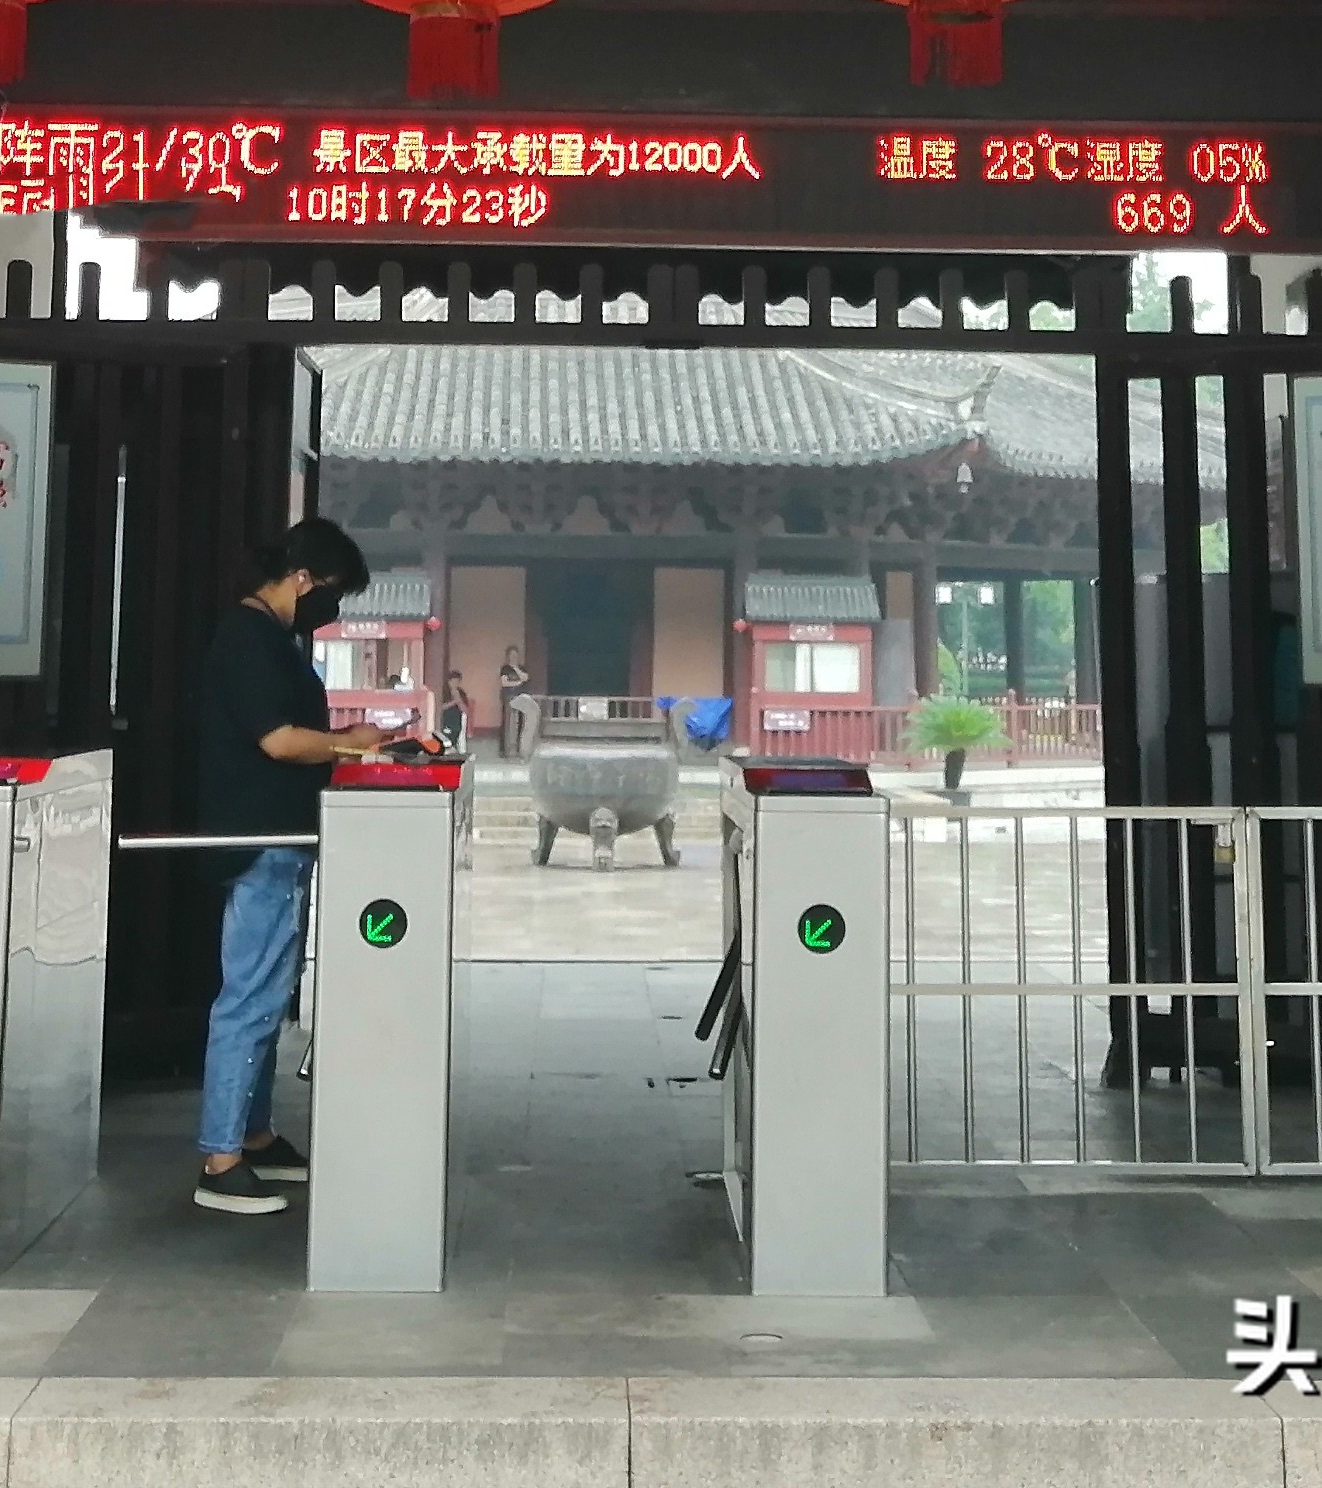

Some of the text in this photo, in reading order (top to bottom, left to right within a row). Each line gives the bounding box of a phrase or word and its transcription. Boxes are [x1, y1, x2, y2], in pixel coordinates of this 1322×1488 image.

[312, 129, 761, 182] 景区最大承载量为12000人
[879, 136, 958, 181] 温度
[287, 186, 548, 228] 10时17分23秒
[1115, 193, 1192, 234] 669
